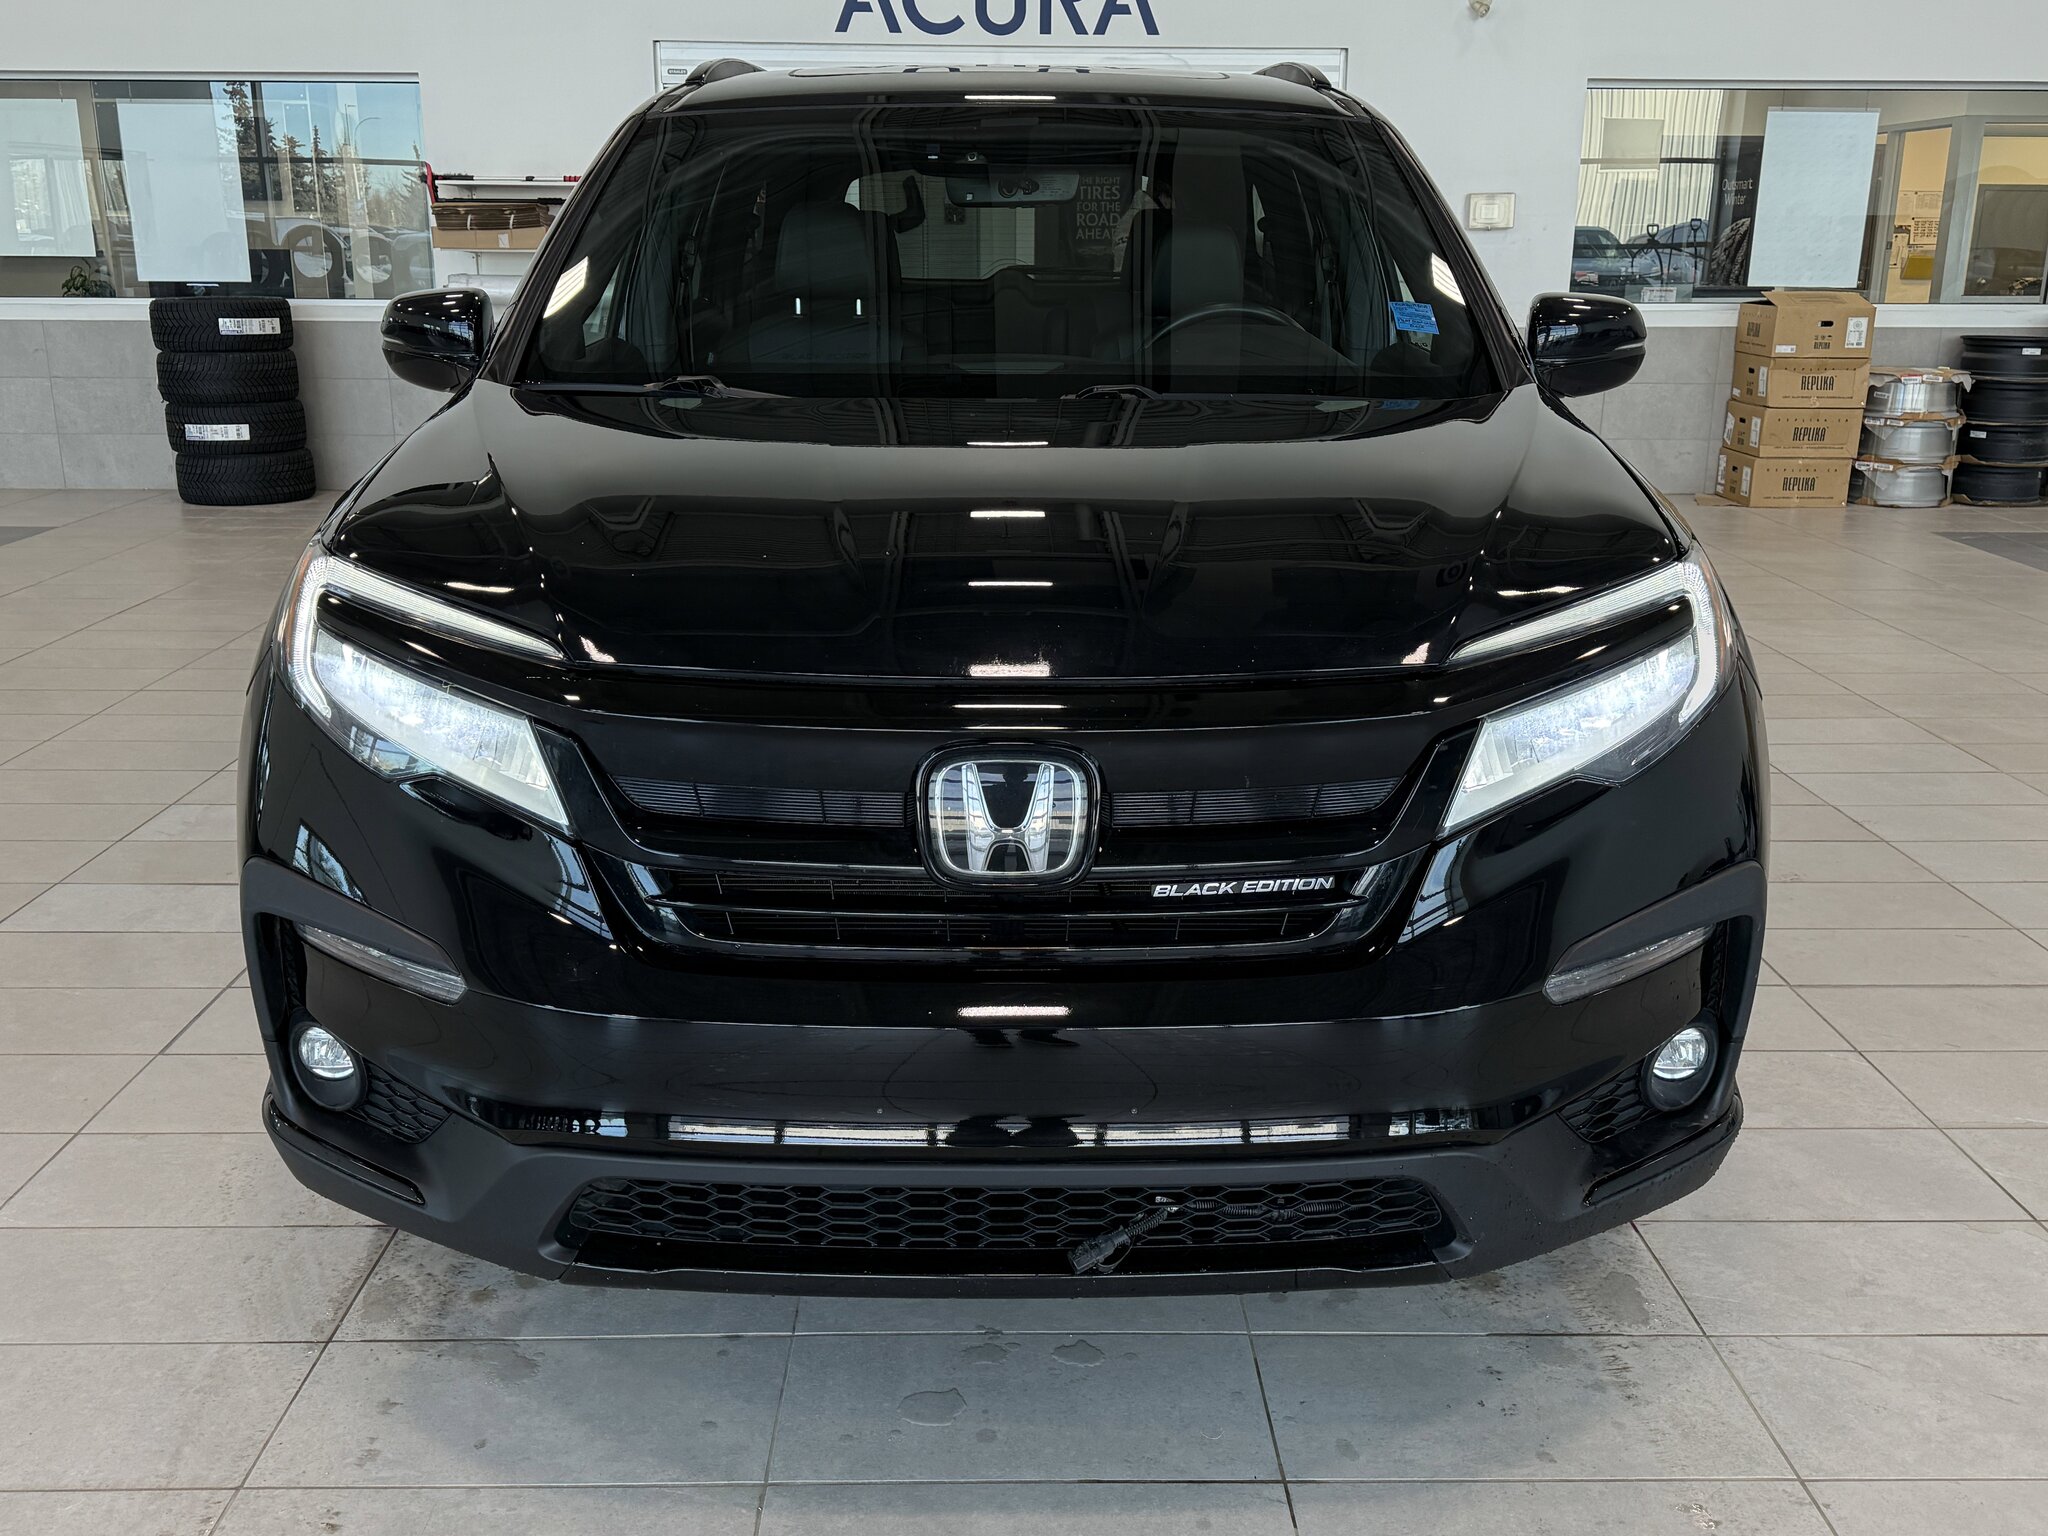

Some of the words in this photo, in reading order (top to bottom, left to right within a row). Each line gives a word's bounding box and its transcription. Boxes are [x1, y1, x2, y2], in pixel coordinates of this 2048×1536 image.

[834, 0, 1161, 36] ACURA
[1080, 185, 1120, 200] TIRES
[1100, 202, 1120, 212] THE
[1076, 212, 1121, 227] ROAD
[1801, 375, 1835, 391] REPLIKA
[1792, 427, 1826, 442] REPLIKA
[1782, 477, 1816, 492] REPLIKA
[1152, 881, 1238, 898] BLACK
[1241, 876, 1334, 895] EDITION
